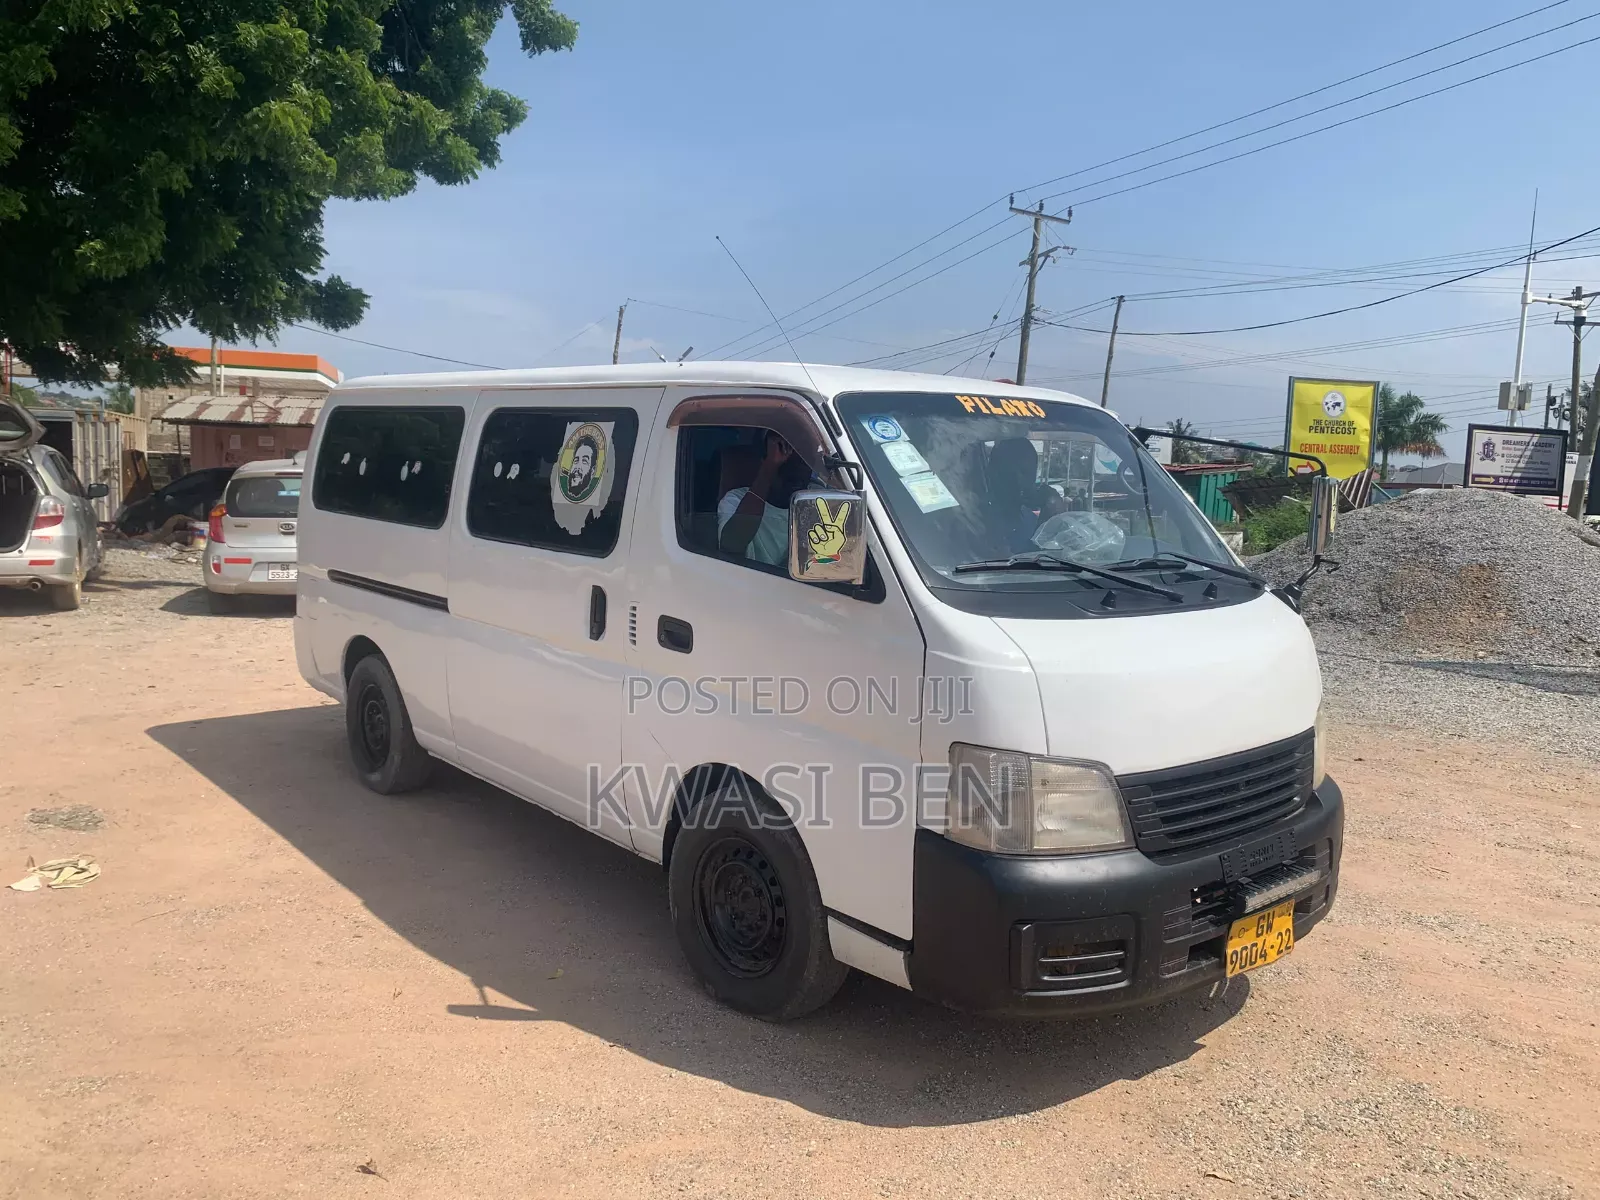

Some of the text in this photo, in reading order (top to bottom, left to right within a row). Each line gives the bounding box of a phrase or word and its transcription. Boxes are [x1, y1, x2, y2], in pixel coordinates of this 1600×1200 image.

[1324, 419, 1347, 427] CHURCH
[1308, 425, 1357, 435] PENTECOST
[1300, 443, 1360, 455] CENTRAL ASSEMBLY
[1531, 441, 1556, 449] ACADEMY
[280, 563, 290, 571] GX
[1255, 910, 1276, 939] GW
